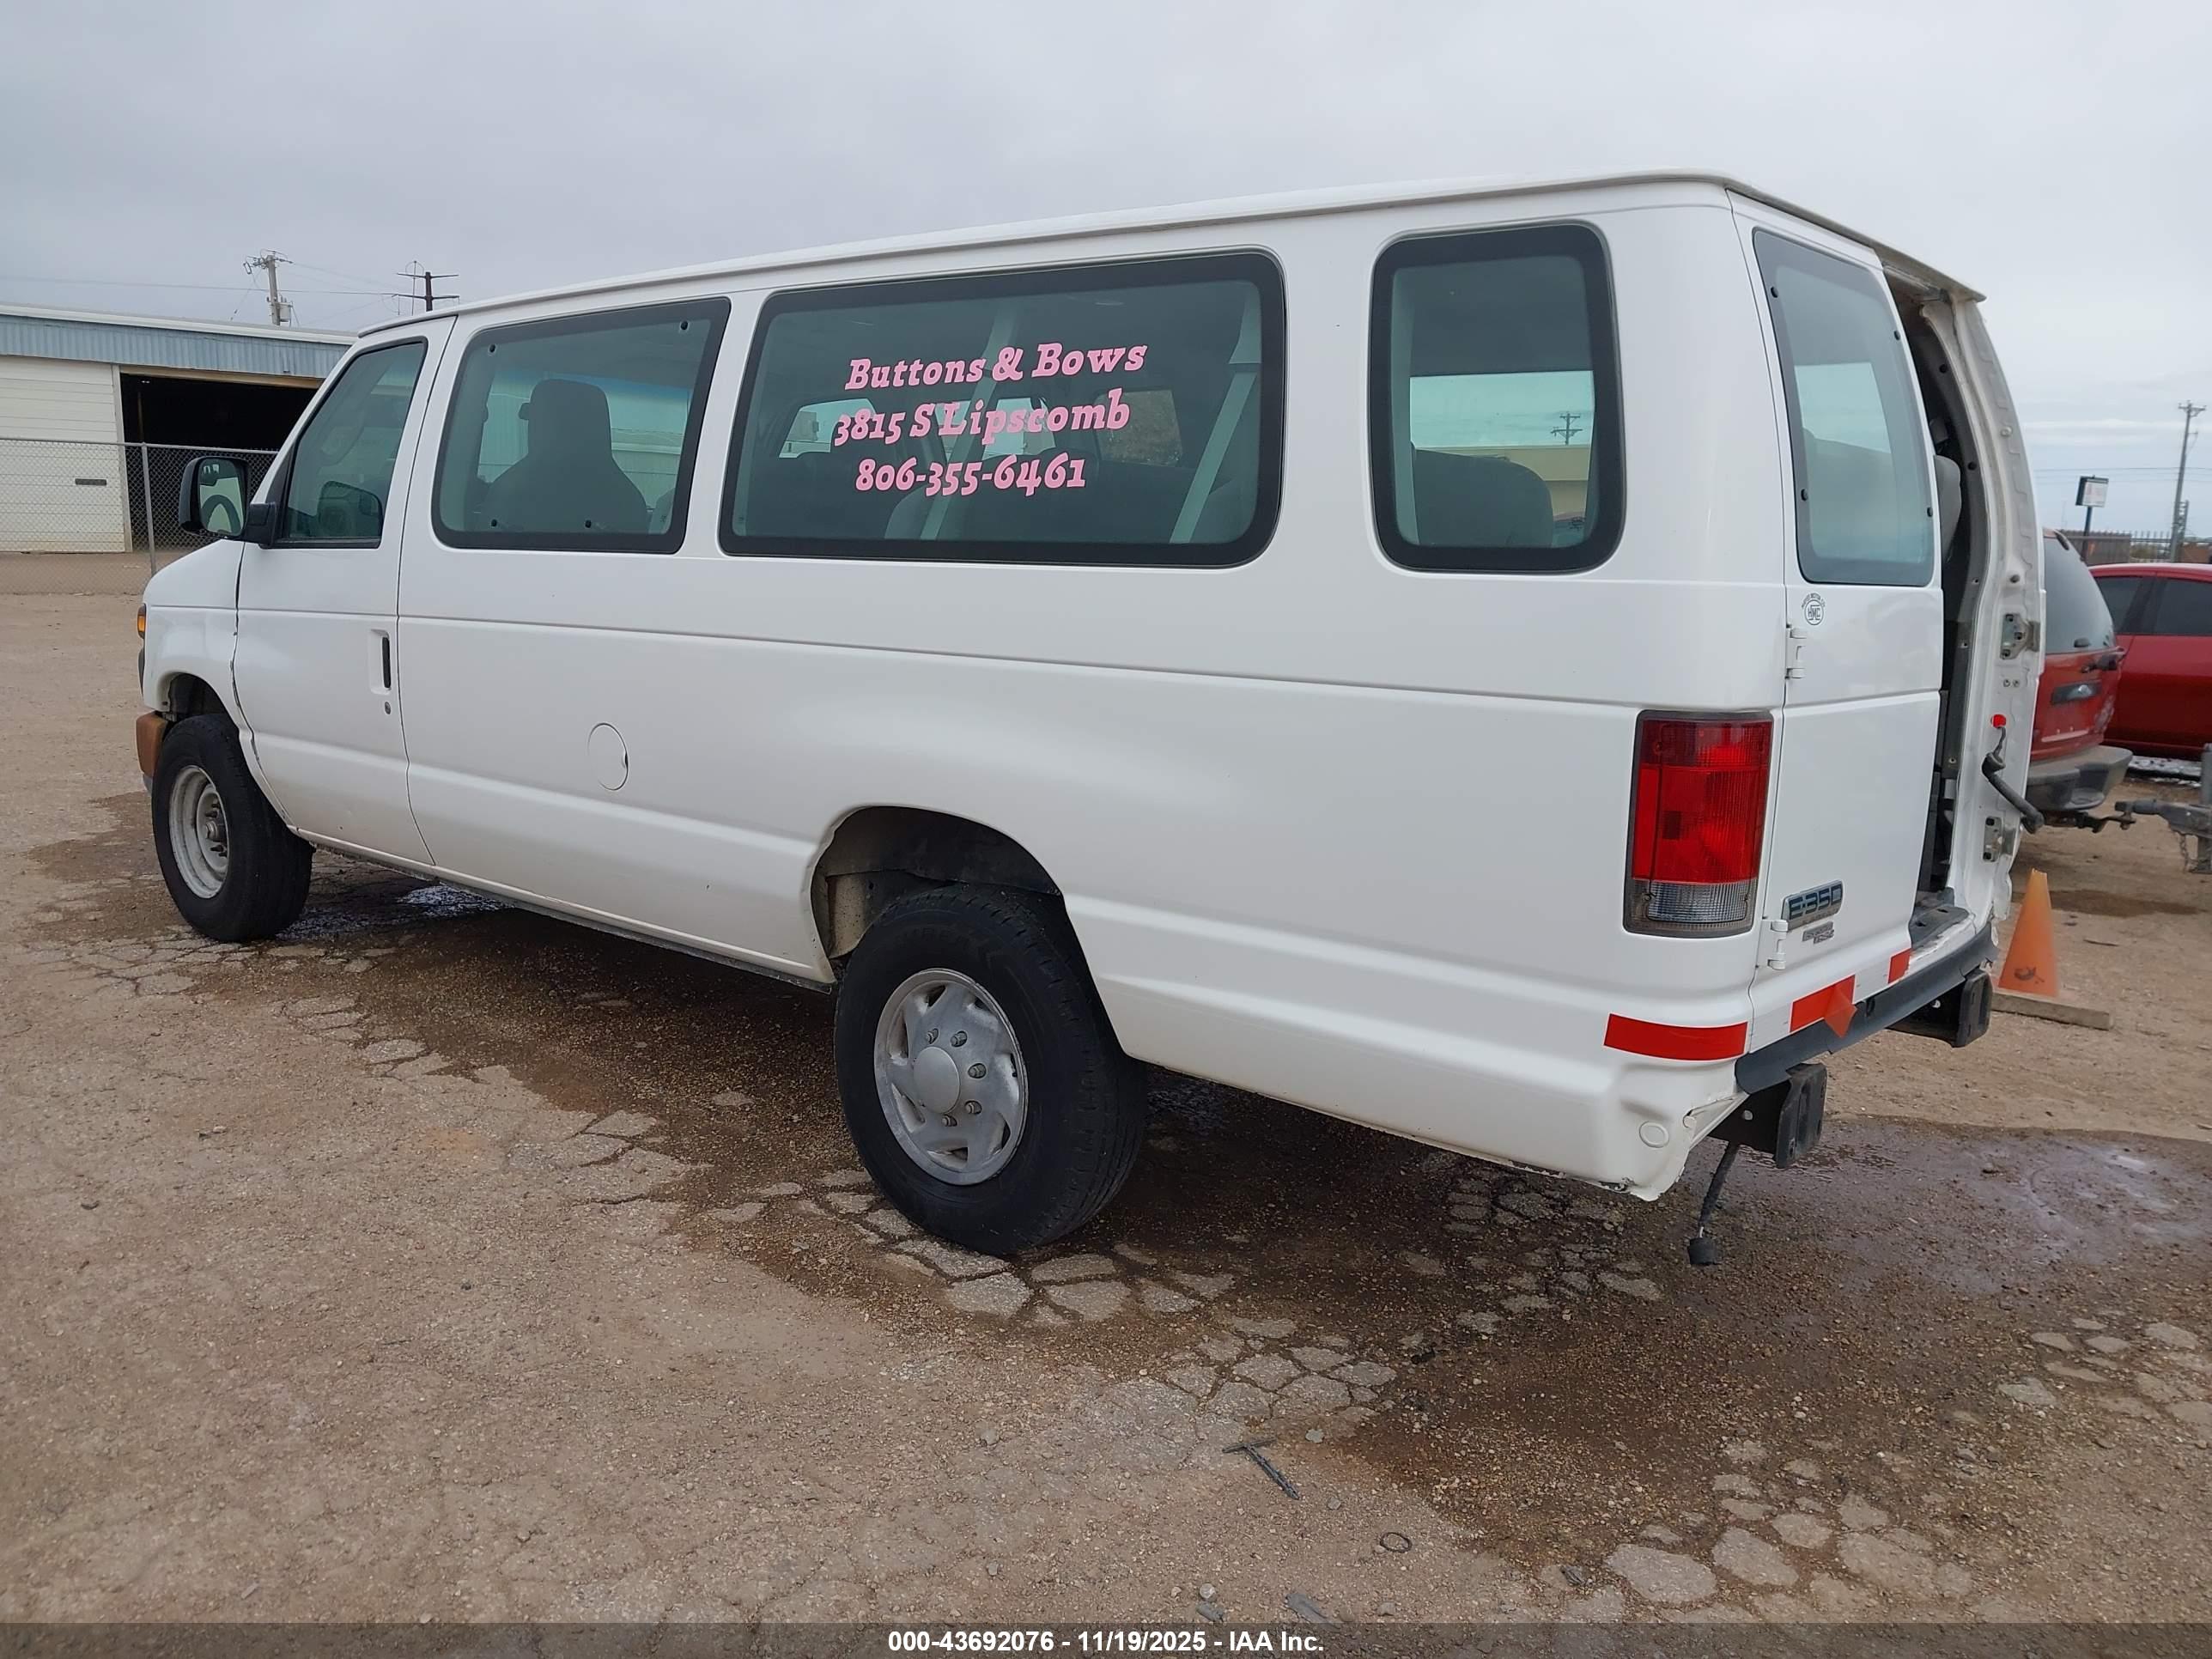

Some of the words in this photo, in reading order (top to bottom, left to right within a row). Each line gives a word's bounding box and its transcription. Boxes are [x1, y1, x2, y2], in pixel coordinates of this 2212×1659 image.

[844, 358, 987, 391] Buttons
[992, 347, 1024, 381] &
[1031, 343, 1147, 378] Bows
[834, 409, 905, 447] 3815
[910, 403, 936, 438] S
[939, 388, 1131, 445] Lipscomb
[855, 453, 1086, 497] 806-355-6461
